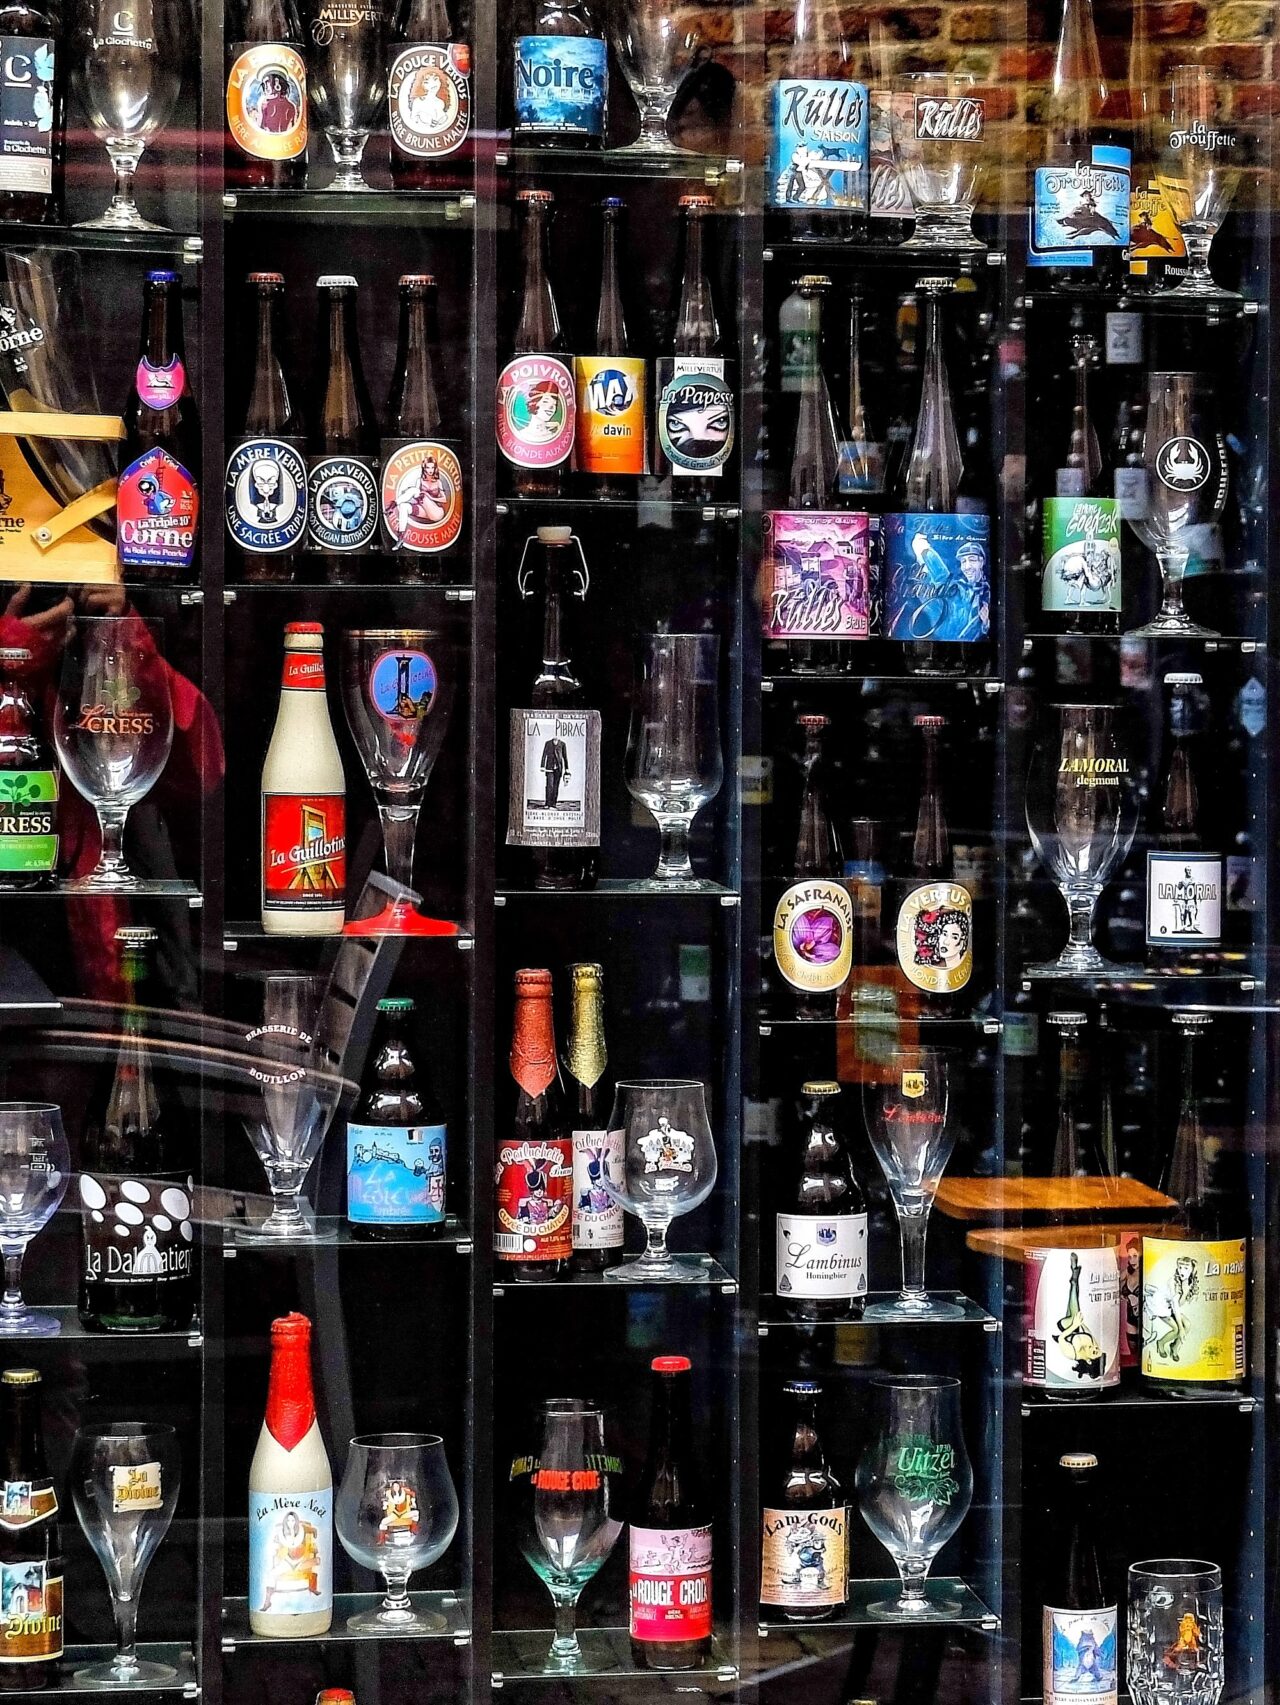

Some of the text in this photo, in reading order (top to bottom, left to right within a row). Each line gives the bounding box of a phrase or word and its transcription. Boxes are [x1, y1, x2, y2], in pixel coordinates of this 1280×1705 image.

[389, 55, 469, 101] LA DOUCE VERTUS
[515, 58, 595, 90] Noire
[390, 110, 469, 149] BIÈRE BRUNE MALTÉE
[811, 129, 860, 144] SAISON
[1193, 120, 1205, 135] la
[1075, 159, 1091, 180] la
[511, 364, 574, 408] POIVROTE
[659, 385, 680, 406] La
[602, 424, 632, 437] davin
[505, 437, 562, 460] BLONDE AUX
[227, 446, 305, 490] LA MÈRE VERTUS
[386, 450, 462, 491] LA PETITE VERTUS
[310, 464, 375, 497] LA MAC VERTUS
[120, 519, 193, 549] Corne
[227, 504, 306, 545] UNE SACRÉE TRIPLE
[404, 526, 441, 545] ROUSSE
[288, 665, 299, 677] La
[87, 717, 154, 735] CRESS
[527, 719, 585, 738] LA PIBRAC
[1058, 757, 1130, 773] LAMORAL
[270, 850, 286, 867] La
[1157, 885, 1218, 901] LAMORAL
[777, 888, 853, 935] LA SAFRANAISE
[245, 1025, 313, 1045] BRASSERIE DE
[249, 1067, 307, 1084] BOUILLON
[498, 1207, 523, 1233] CUVÉE
[523, 1223, 537, 1235] DU
[785, 1241, 863, 1270] Lambinus
[806, 1271, 848, 1281] Honingbier
[1204, 1260, 1220, 1278] La
[897, 1446, 956, 1472] Uitzet
[256, 1497, 327, 1521] La Mère Noël
[808, 1512, 845, 1536] Gods
[638, 1580, 674, 1605] ROUGE
